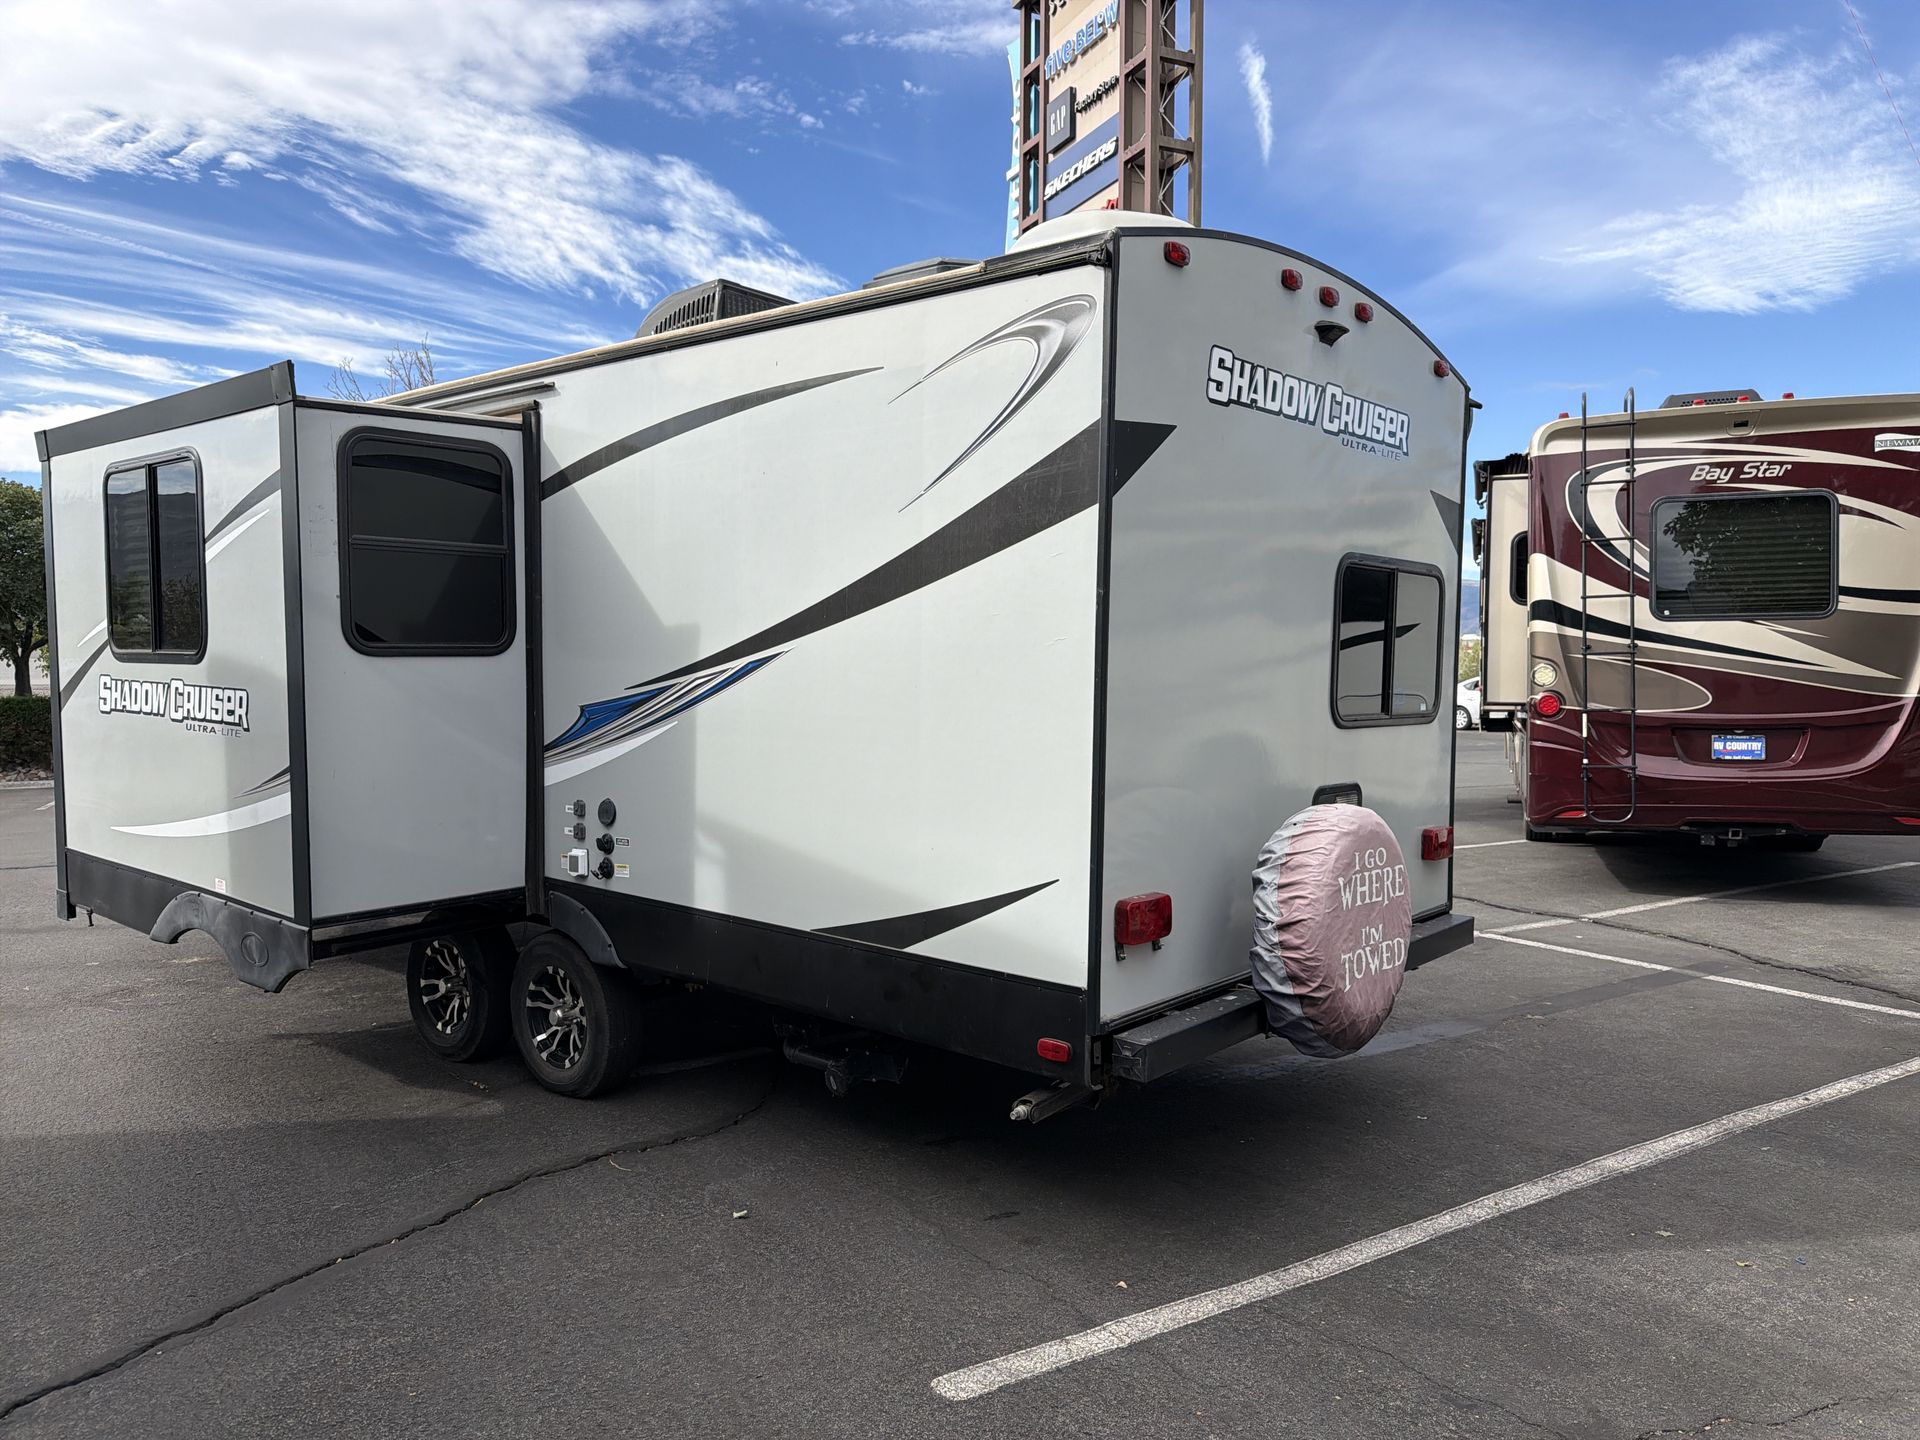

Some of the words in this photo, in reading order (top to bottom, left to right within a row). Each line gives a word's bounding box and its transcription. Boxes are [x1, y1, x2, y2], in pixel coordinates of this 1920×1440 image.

[1050, 104, 1066, 136] GAP
[1044, 136, 1118, 201] SKECHERS
[1341, 437, 1401, 461] ULTRA-LITE
[1689, 464, 1734, 483] Bay
[1739, 461, 1793, 479] Star
[185, 723, 242, 738] ULTRA-LITE
[1713, 741, 1724, 750] RV
[1725, 741, 1762, 751] COUNTRY
[1354, 852, 1361, 871] I
[1364, 847, 1387, 868] GO
[1338, 864, 1405, 911] WHERE
[1361, 923, 1383, 947] I'M
[1341, 937, 1405, 993] TOWED
